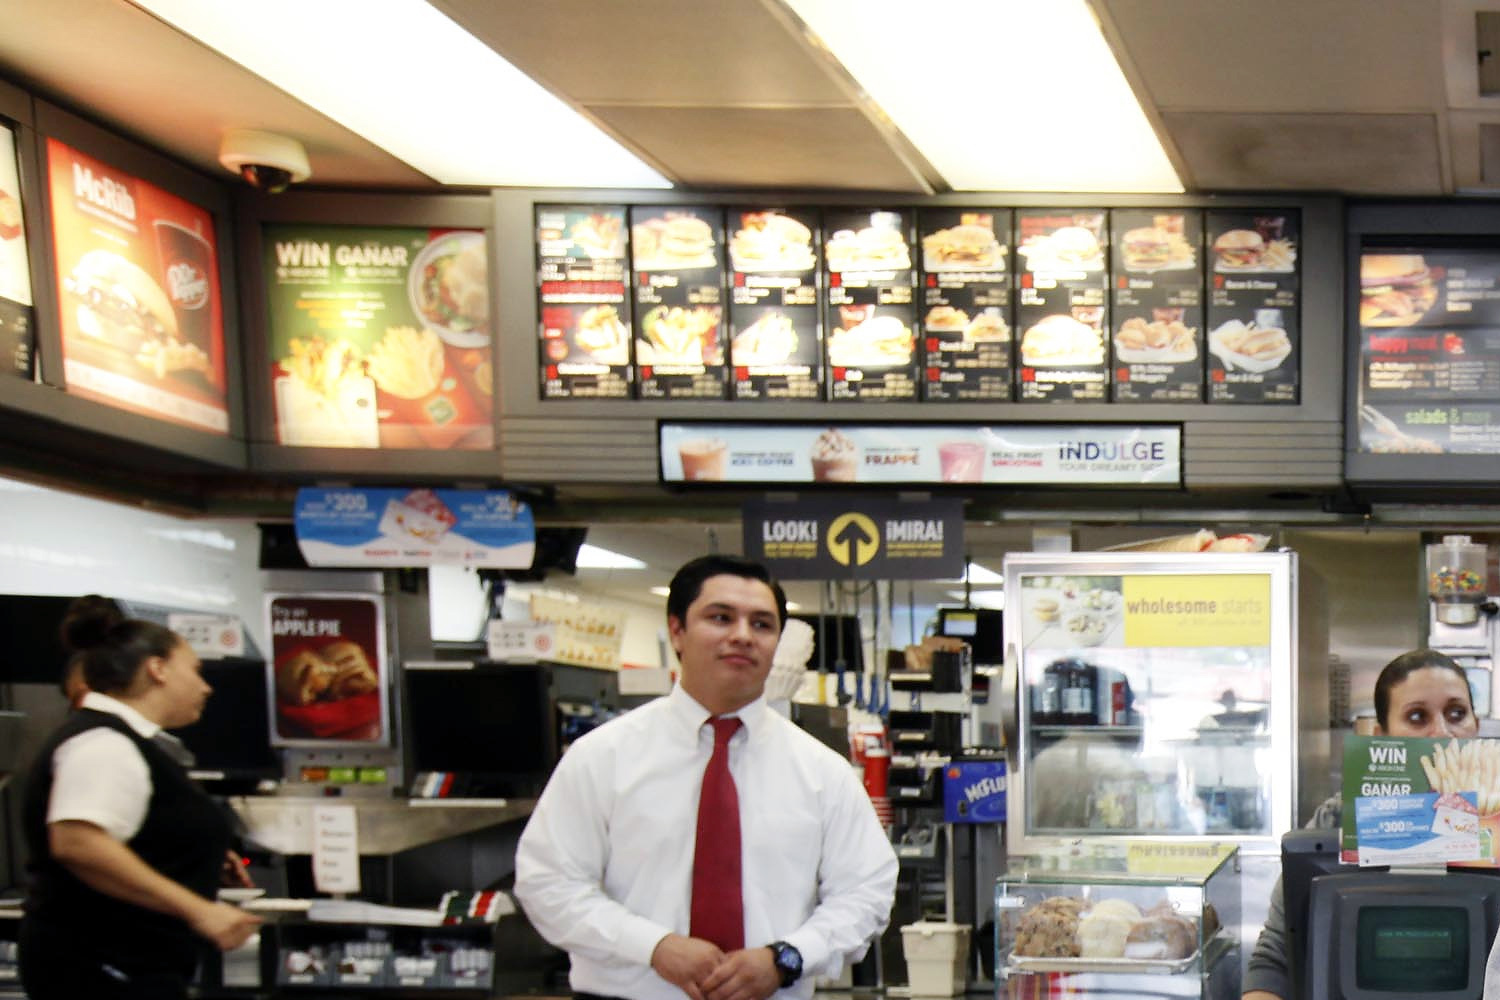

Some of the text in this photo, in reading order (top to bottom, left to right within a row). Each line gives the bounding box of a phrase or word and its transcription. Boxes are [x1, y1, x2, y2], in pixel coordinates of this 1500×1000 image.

[275, 242, 331, 266] WIN
[335, 245, 408, 266] GANAR
[1405, 408, 1447, 424] salads
[1059, 442, 1165, 460] INDULGE
[762, 520, 818, 541] LOOK!
[1127, 598, 1217, 614] wholesome
[273, 620, 341, 637] APPLE PIE
[1369, 747, 1407, 764] WIN
[1361, 783, 1412, 796] GANAR
[1379, 821, 1405, 832] $300
